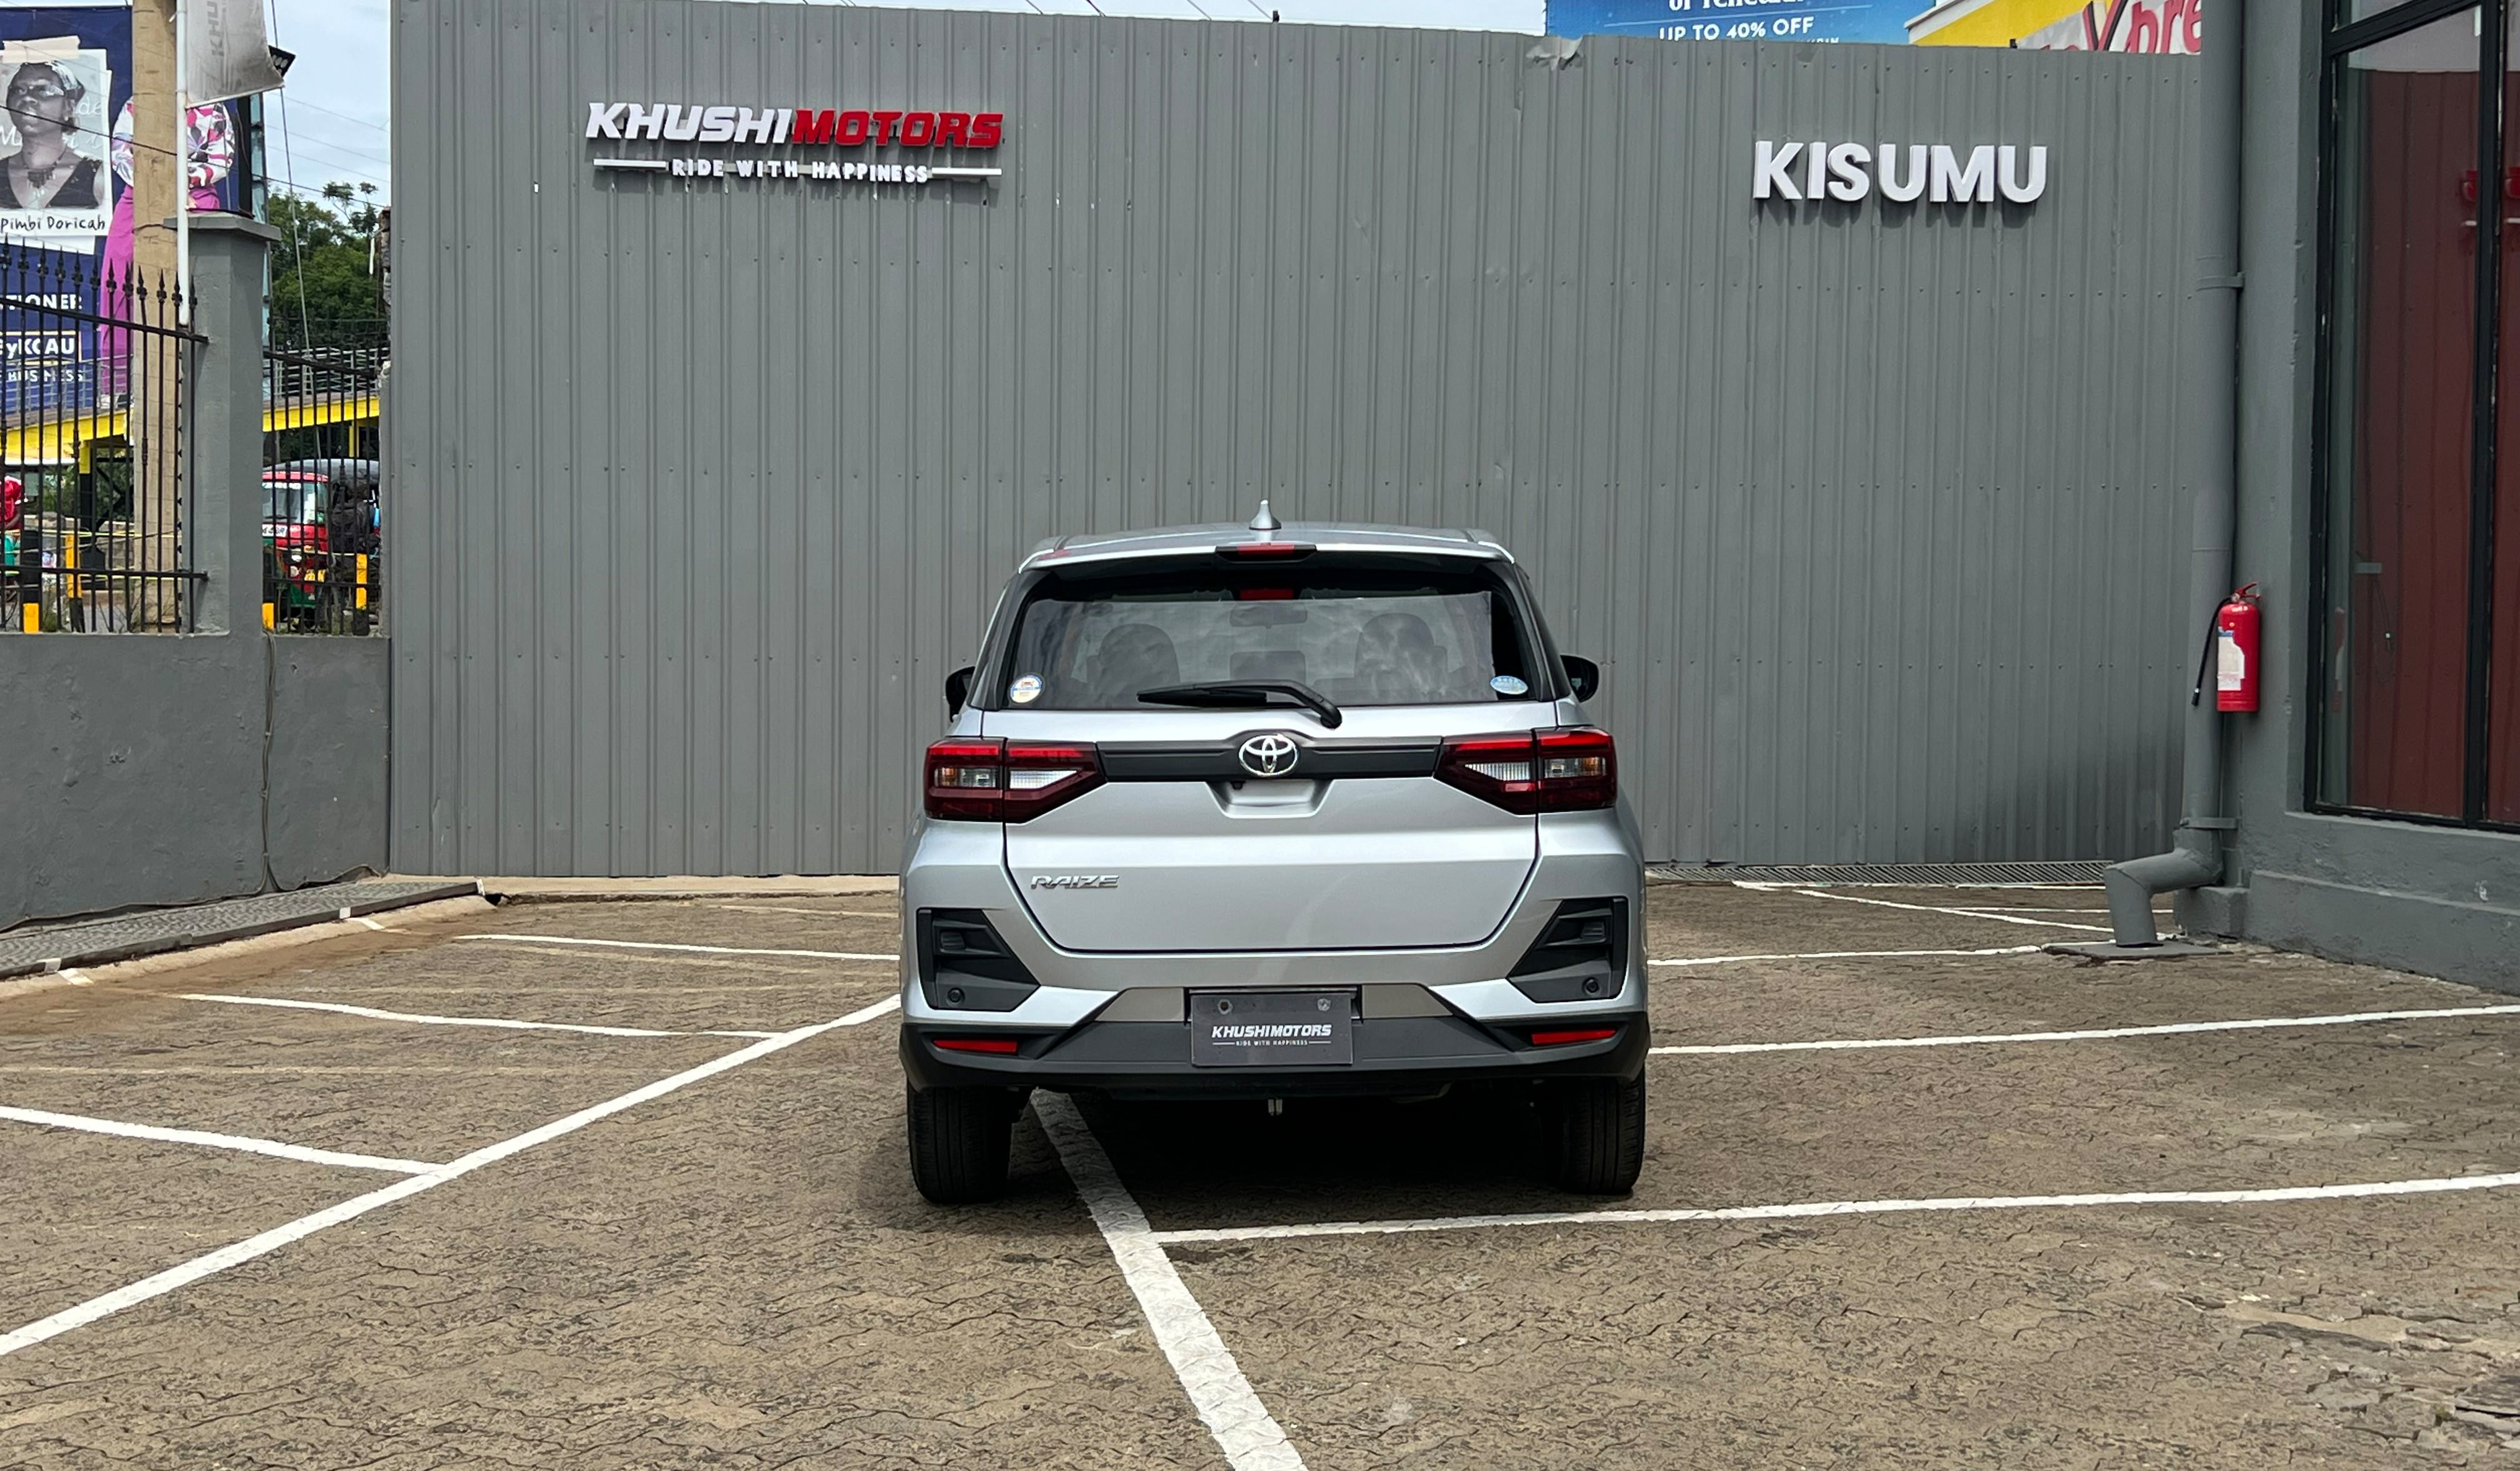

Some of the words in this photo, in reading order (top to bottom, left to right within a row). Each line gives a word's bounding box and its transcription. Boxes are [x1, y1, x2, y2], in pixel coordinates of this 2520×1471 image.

[1692, 24, 1720, 40] TO
[1726, 21, 1766, 38] 40%
[1773, 16, 1814, 36] OFF
[672, 158, 724, 177] RIDE
[736, 159, 799, 179] WITH
[811, 161, 928, 183] HAPPINESS
[1753, 140, 2048, 203] KISUMU
[47, 216, 105, 231] Doricah
[1031, 874, 1119, 889] RAIZE
[1211, 1024, 1332, 1038] KHUSHIMOTORS
